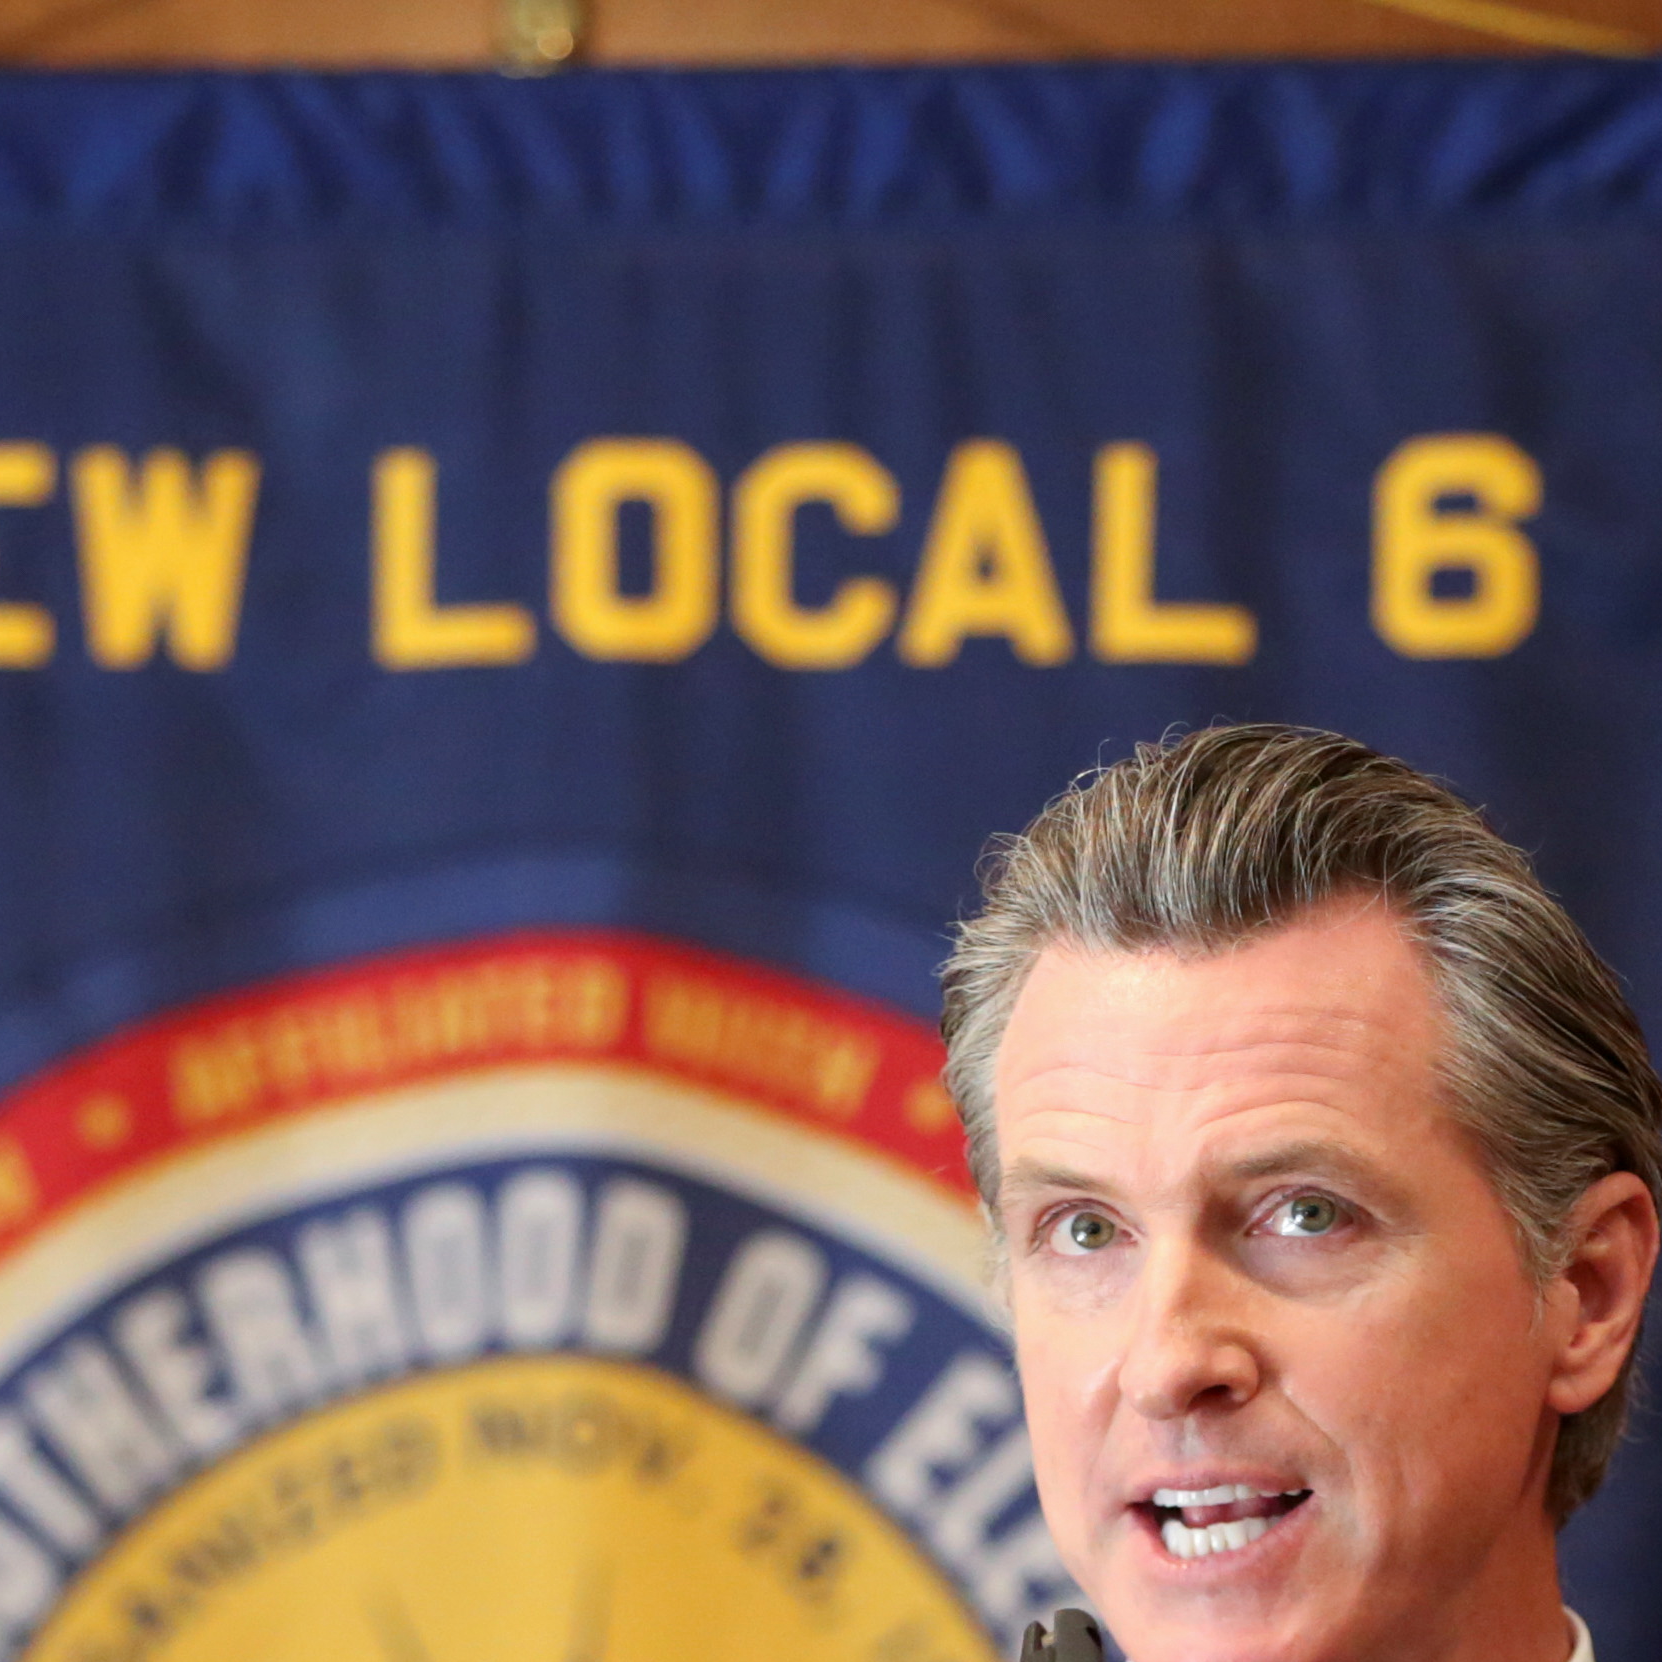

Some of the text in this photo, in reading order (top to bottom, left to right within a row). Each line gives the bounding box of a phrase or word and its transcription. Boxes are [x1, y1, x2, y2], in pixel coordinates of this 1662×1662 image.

[372, 437, 1256, 669] LOCAL
[1370, 434, 1542, 659] 6
[693, 1226, 916, 1435] OF
